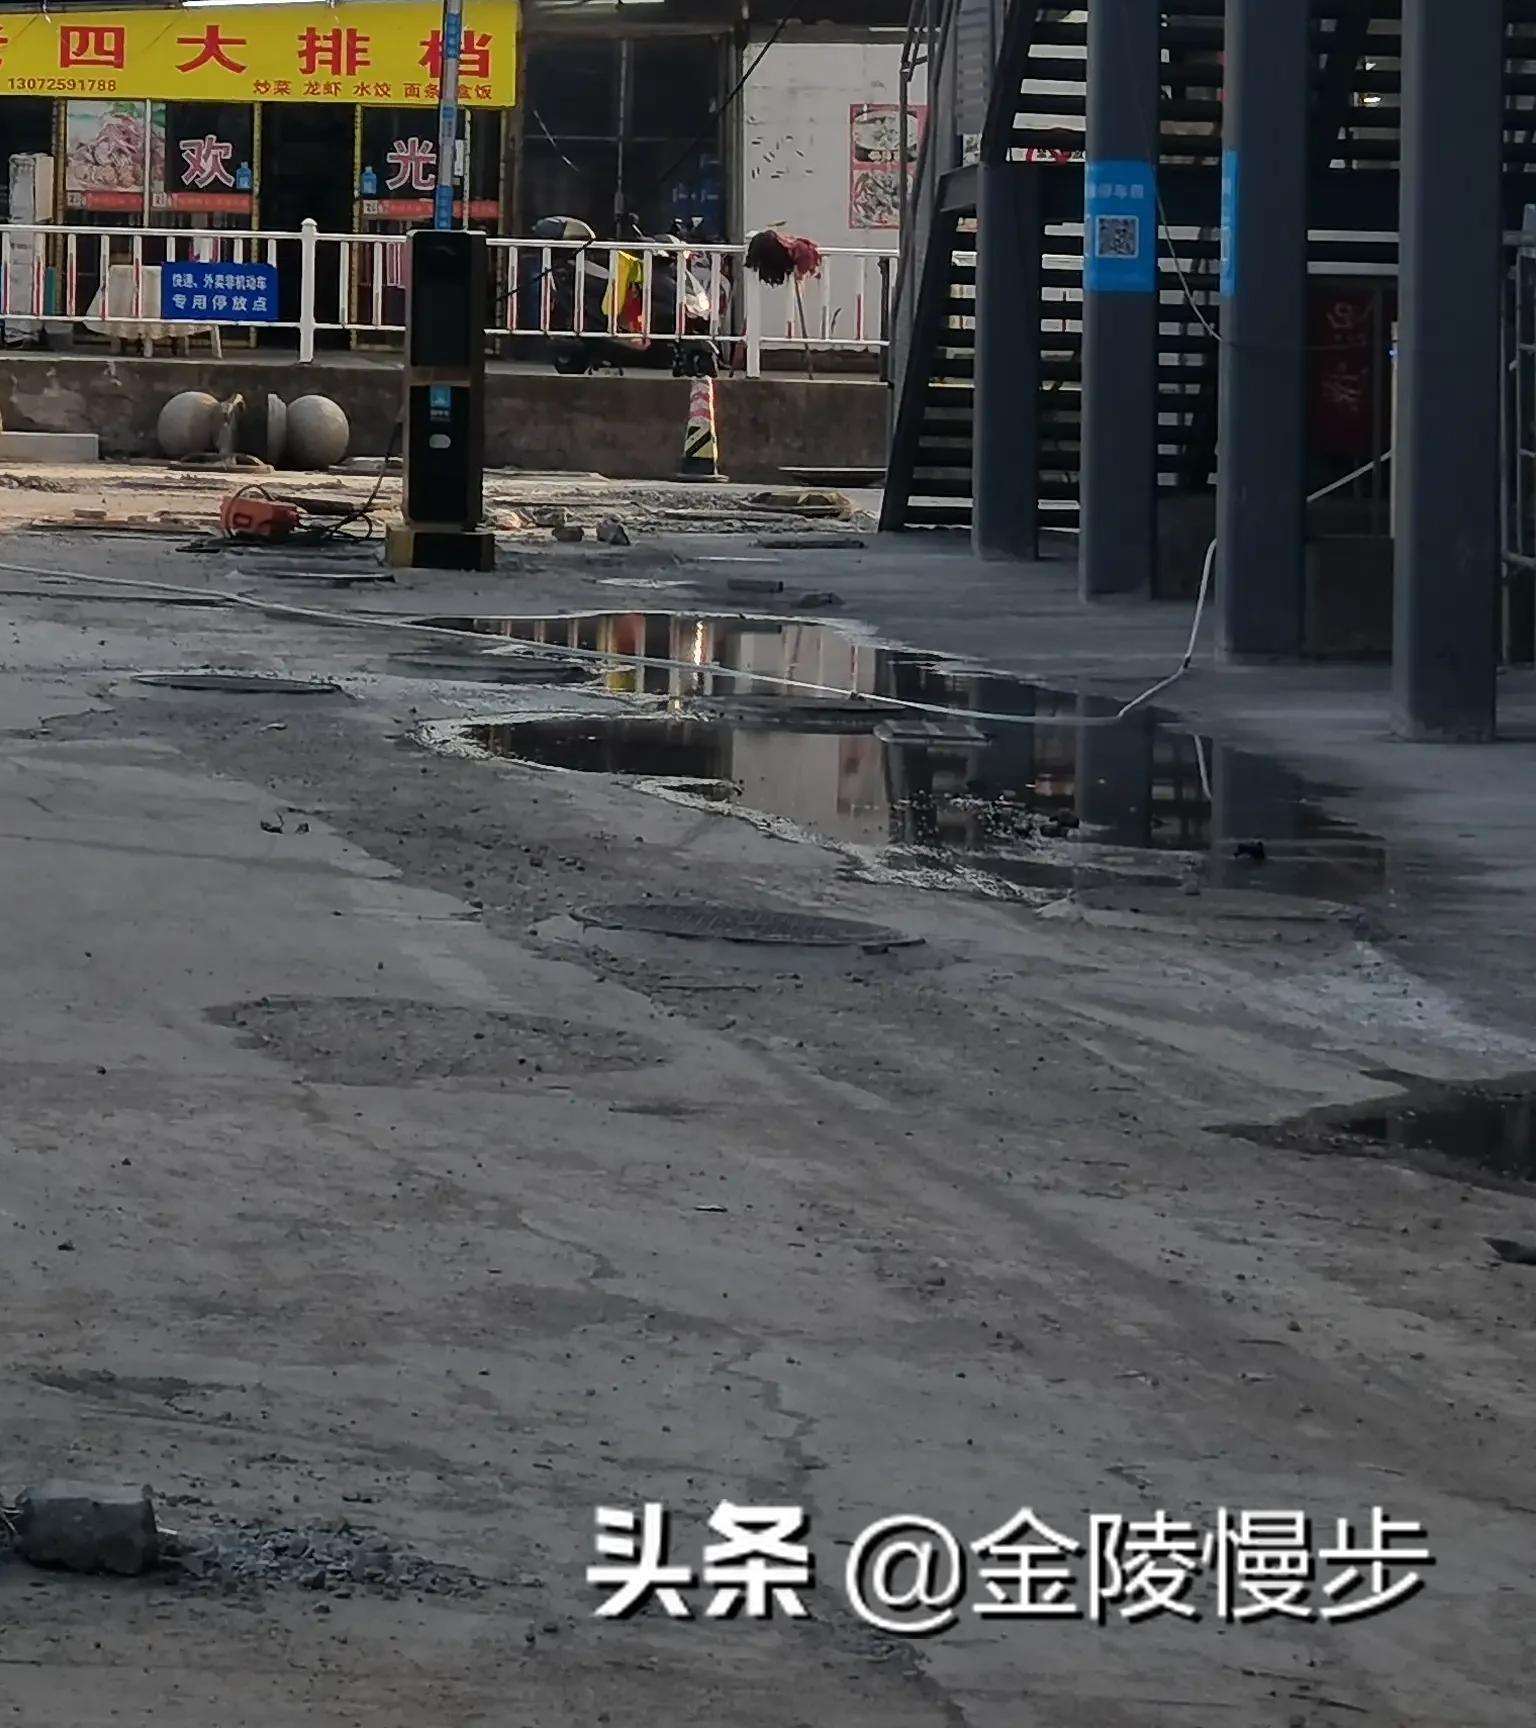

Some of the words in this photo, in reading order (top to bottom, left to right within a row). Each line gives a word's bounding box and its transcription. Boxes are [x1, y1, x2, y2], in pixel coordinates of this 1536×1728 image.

[252, 78, 292, 97] 炒菜
[303, 79, 342, 98] 龙虾
[172, 293, 268, 312] 专用停放点
